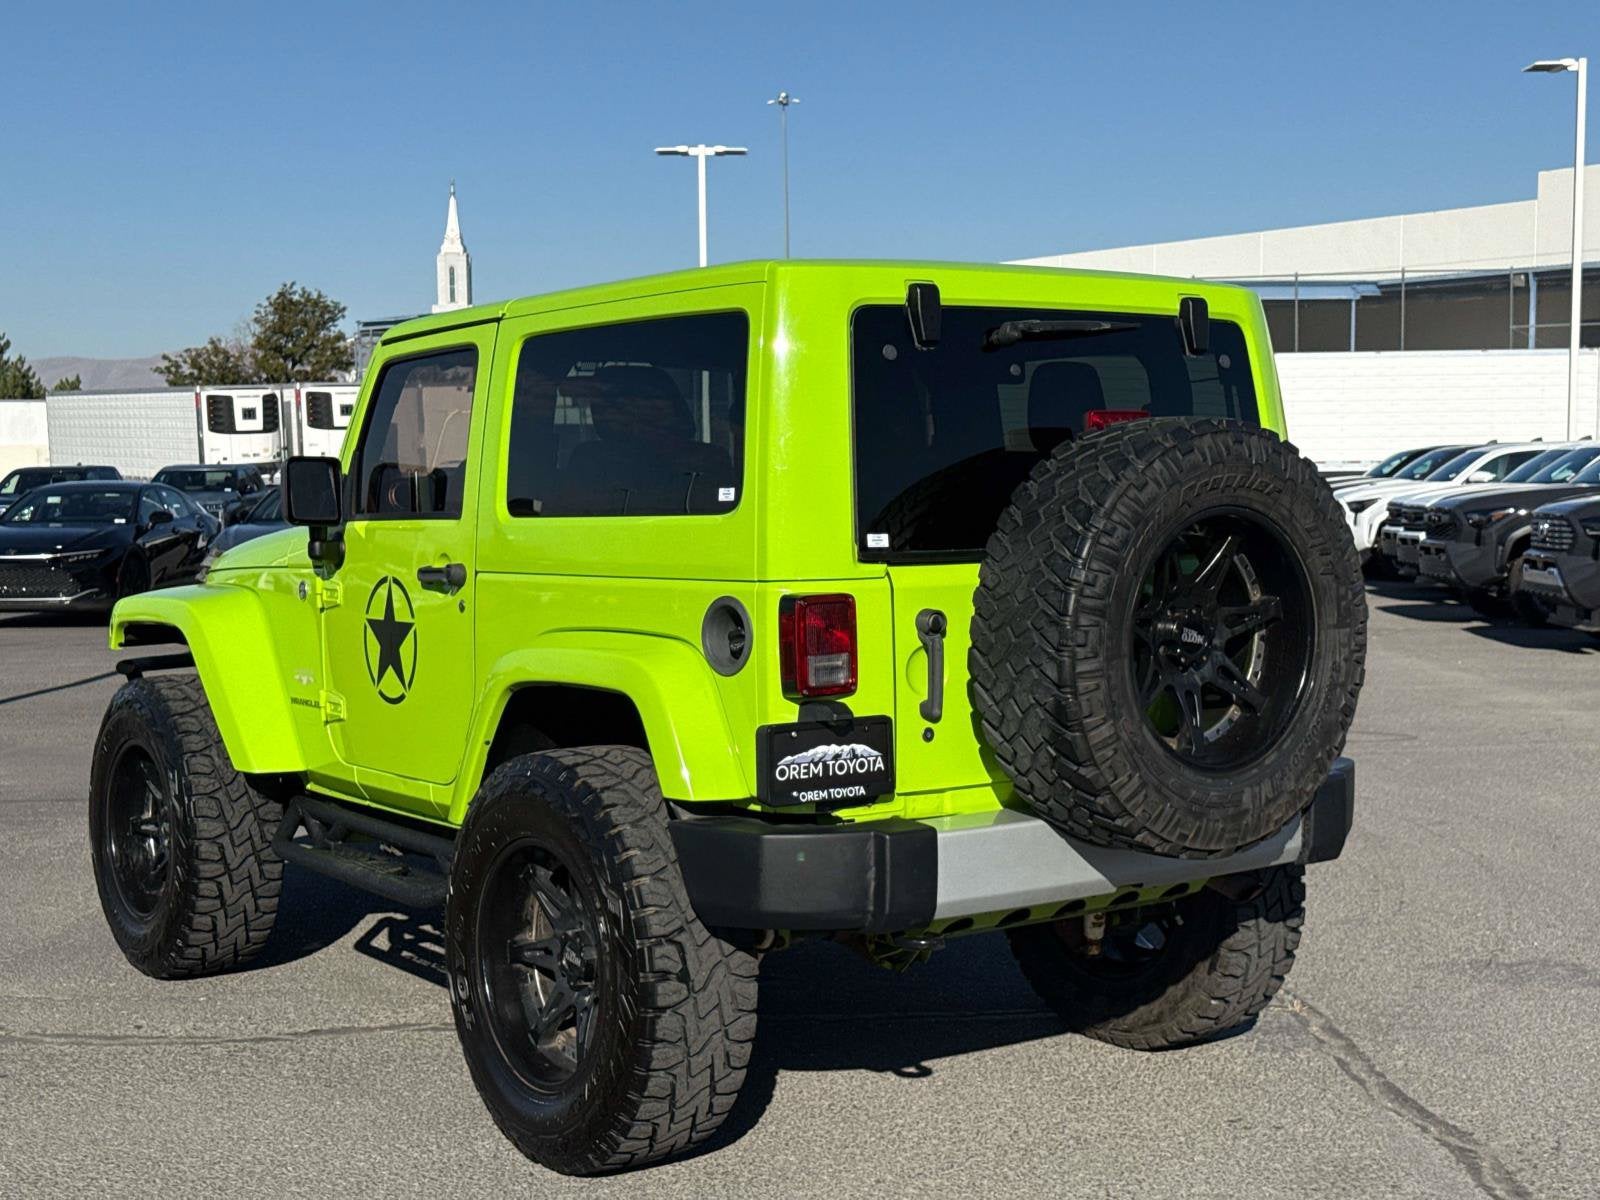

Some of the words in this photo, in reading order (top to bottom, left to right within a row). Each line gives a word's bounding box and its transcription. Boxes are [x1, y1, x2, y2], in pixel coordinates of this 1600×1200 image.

[775, 763, 823, 782] OREM
[827, 756, 885, 776] TOYOTA
[799, 791, 828, 802] OREM
[829, 786, 866, 799] TOYOTA
